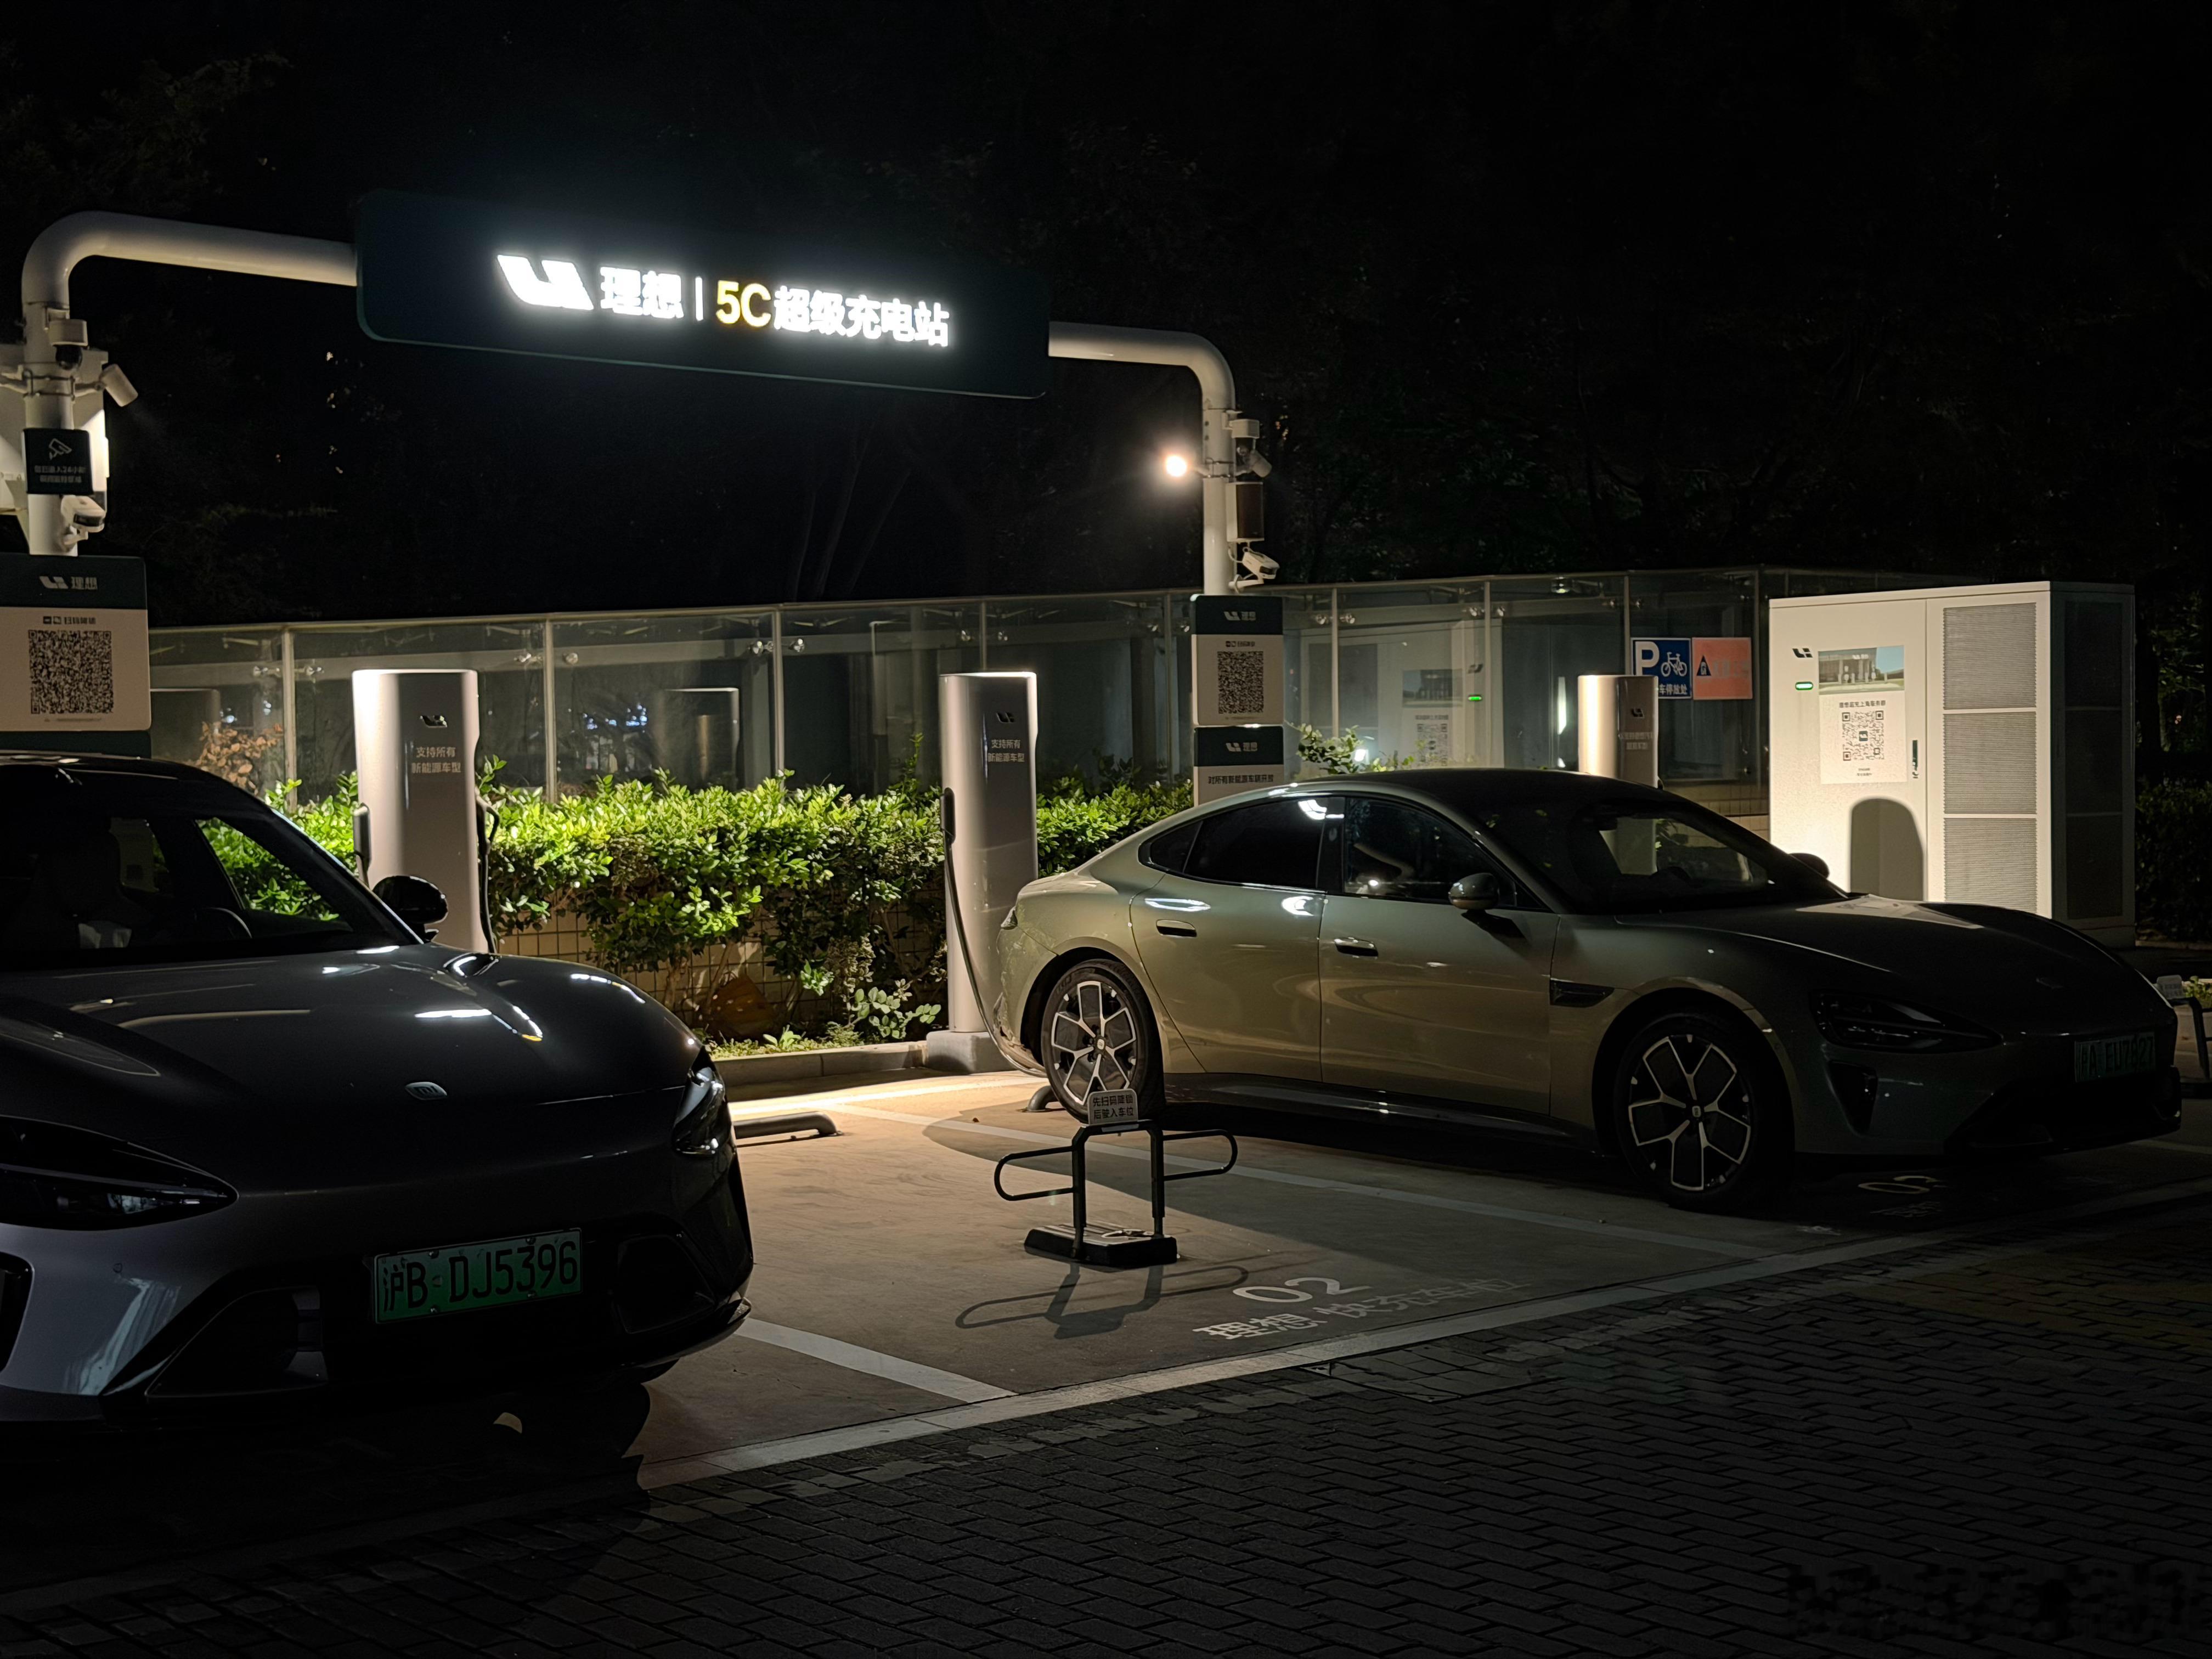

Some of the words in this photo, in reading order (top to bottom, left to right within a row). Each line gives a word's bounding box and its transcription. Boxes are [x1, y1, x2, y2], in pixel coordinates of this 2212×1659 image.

[600, 267, 684, 318] 理想
[716, 280, 949, 347] 5C超级充电站
[1635, 641, 1660, 676] P
[416, 747, 456, 758] 支持所有
[988, 753, 1025, 762] 新能源车型
[991, 740, 1020, 749] 支持所有
[411, 762, 461, 774] 新能源车型
[384, 1262, 428, 1312] 沪B
[449, 1241, 578, 1302] DJ5396
[1232, 1277, 1371, 1303] 02
[1193, 1313, 1328, 1340] 理想
